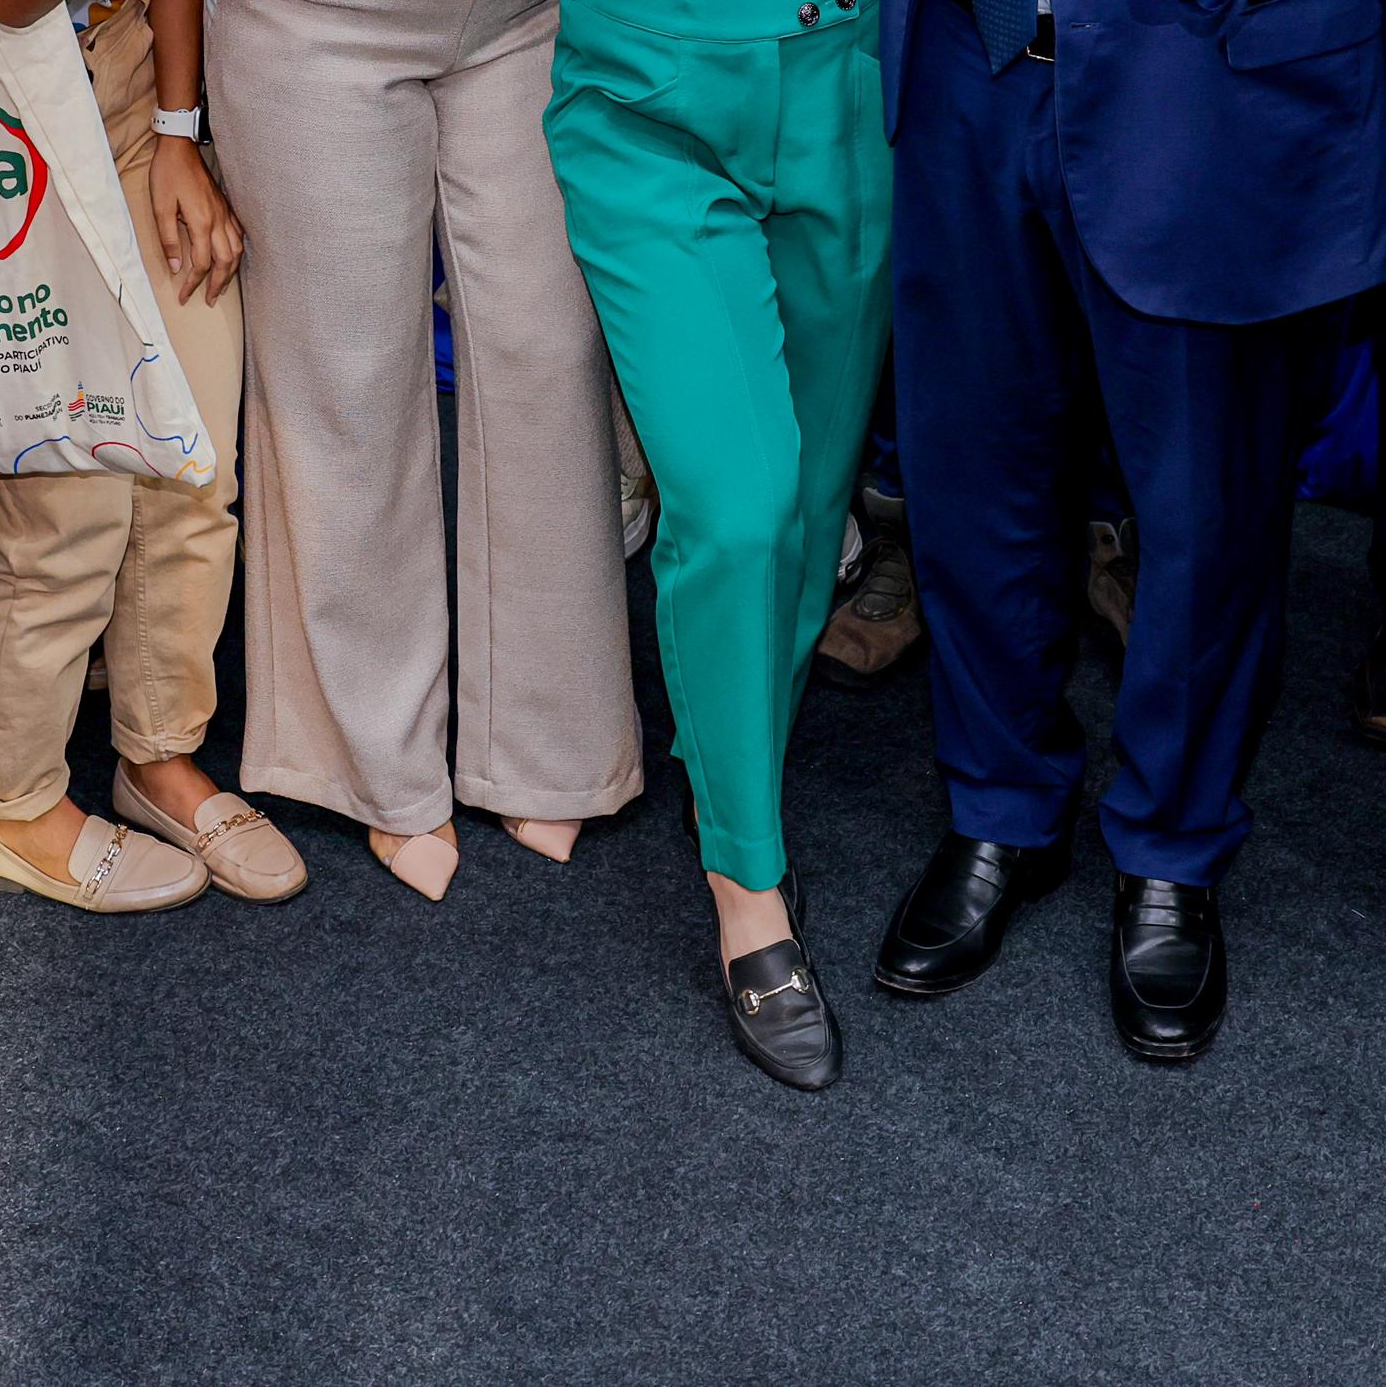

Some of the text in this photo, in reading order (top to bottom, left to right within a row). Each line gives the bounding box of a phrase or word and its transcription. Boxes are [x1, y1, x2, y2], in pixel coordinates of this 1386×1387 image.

[17, 284, 51, 314] no
[13, 359, 42, 374] PIAUÍ
[85, 394, 125, 404] GOVERNO DO
[86, 402, 125, 415] PIAUÍ
